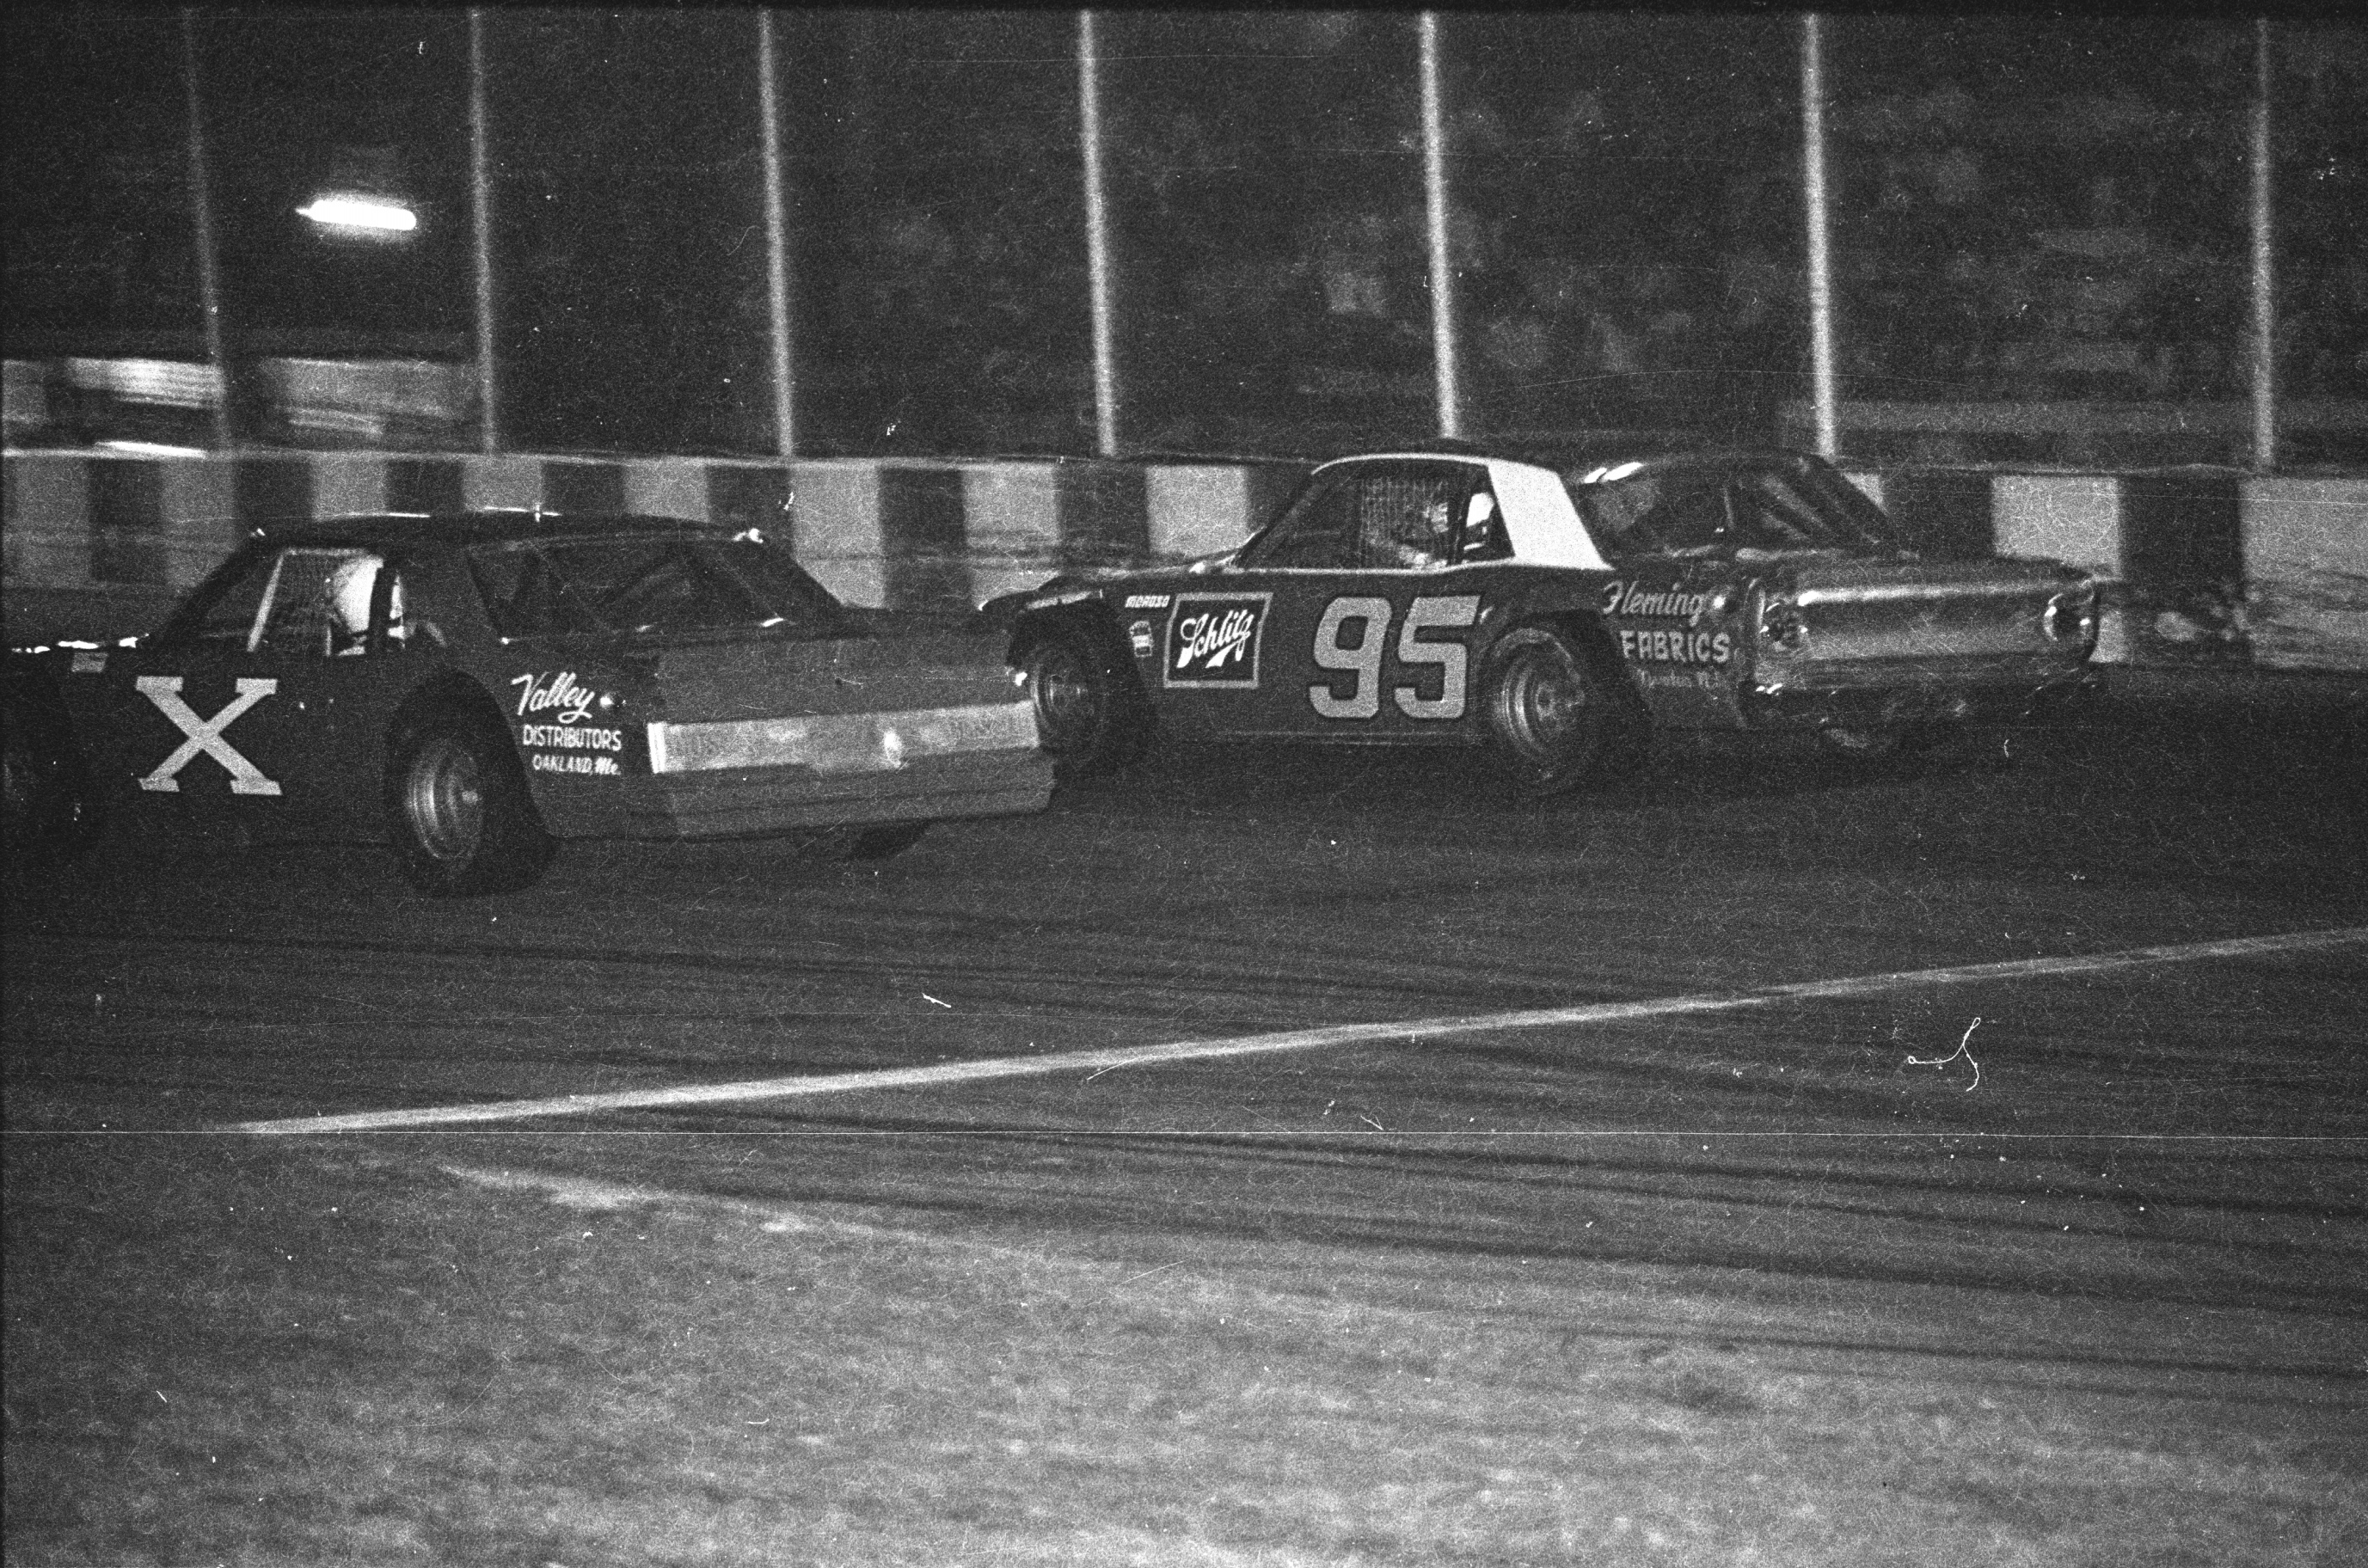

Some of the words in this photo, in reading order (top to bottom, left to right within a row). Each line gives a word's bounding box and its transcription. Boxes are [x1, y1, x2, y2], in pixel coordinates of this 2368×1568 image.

[1603, 580, 1703, 628] Fleming
[1176, 609, 1255, 669] Schlitz
[1309, 596, 1481, 719] 95
[1620, 630, 1731, 663] FABRICS
[511, 671, 595, 724] Valley
[135, 676, 283, 796] X
[523, 725, 622, 750] DISTRIBUTORS
